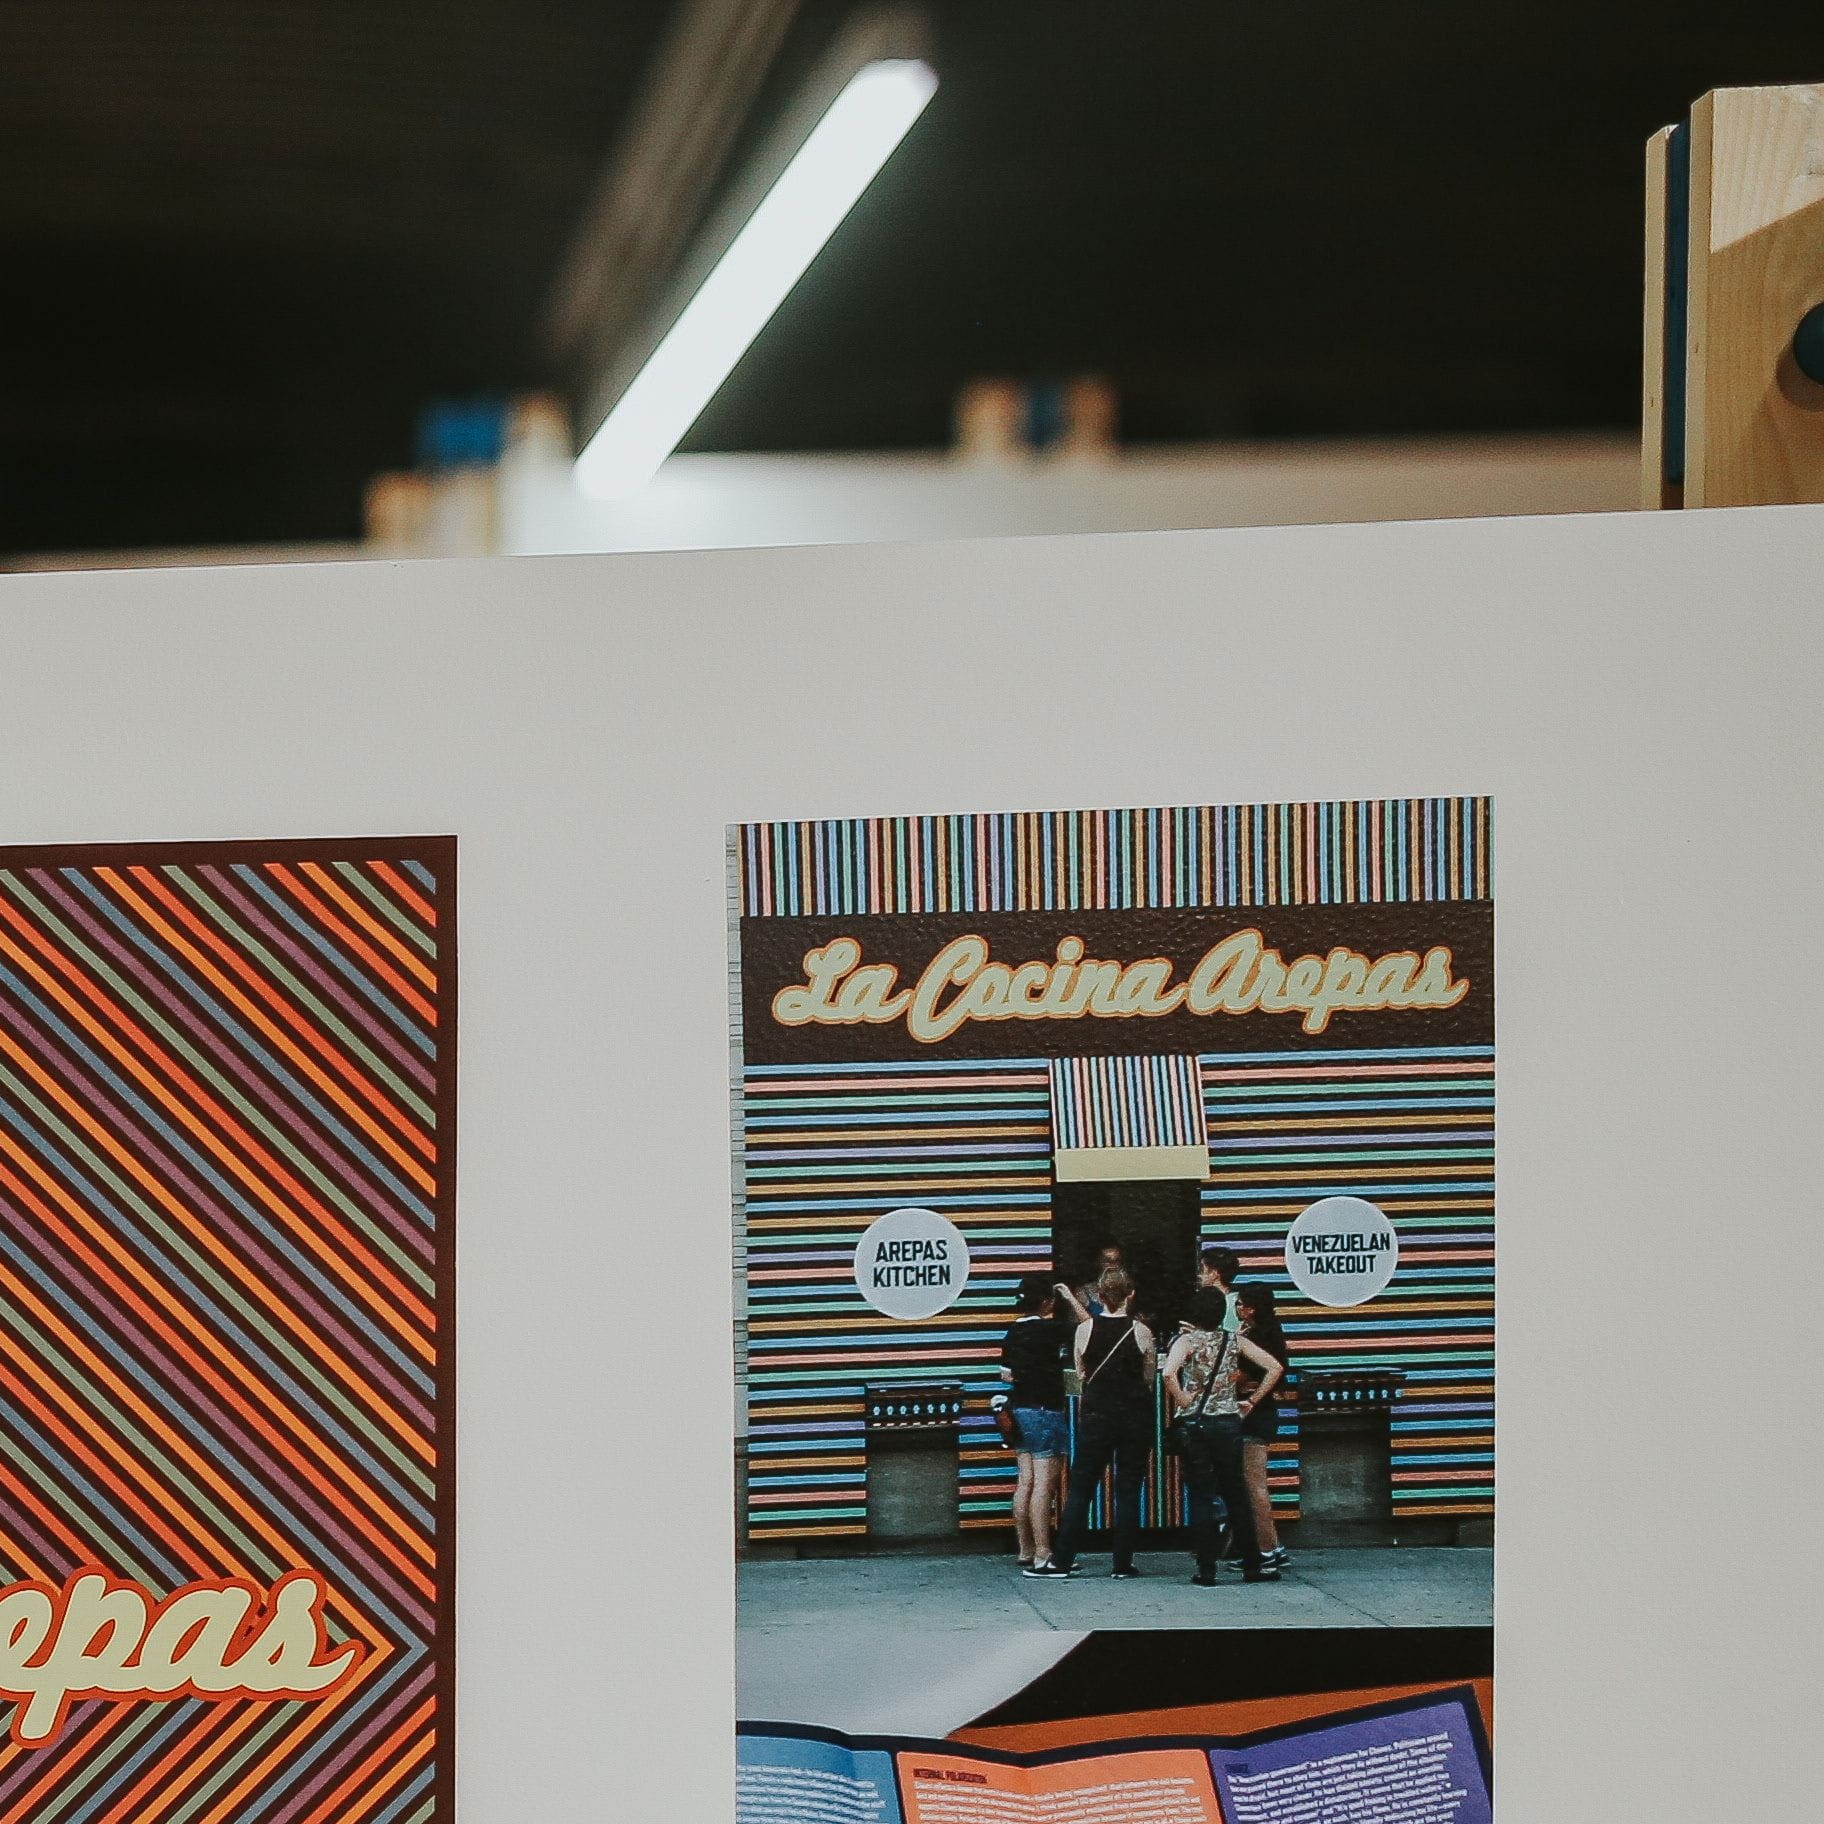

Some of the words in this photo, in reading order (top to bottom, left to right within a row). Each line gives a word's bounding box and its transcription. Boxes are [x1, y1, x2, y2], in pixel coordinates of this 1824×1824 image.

[776, 939, 911, 1024] La
[908, 936, 1190, 1041] Cocina
[1188, 930, 1468, 1032] Arepas
[875, 1240, 948, 1261] AREPAS
[1293, 1232, 1391, 1254] VENEZUELAN
[1307, 1254, 1376, 1276] TAKEOUT
[873, 1265, 951, 1288] KITCHEN
